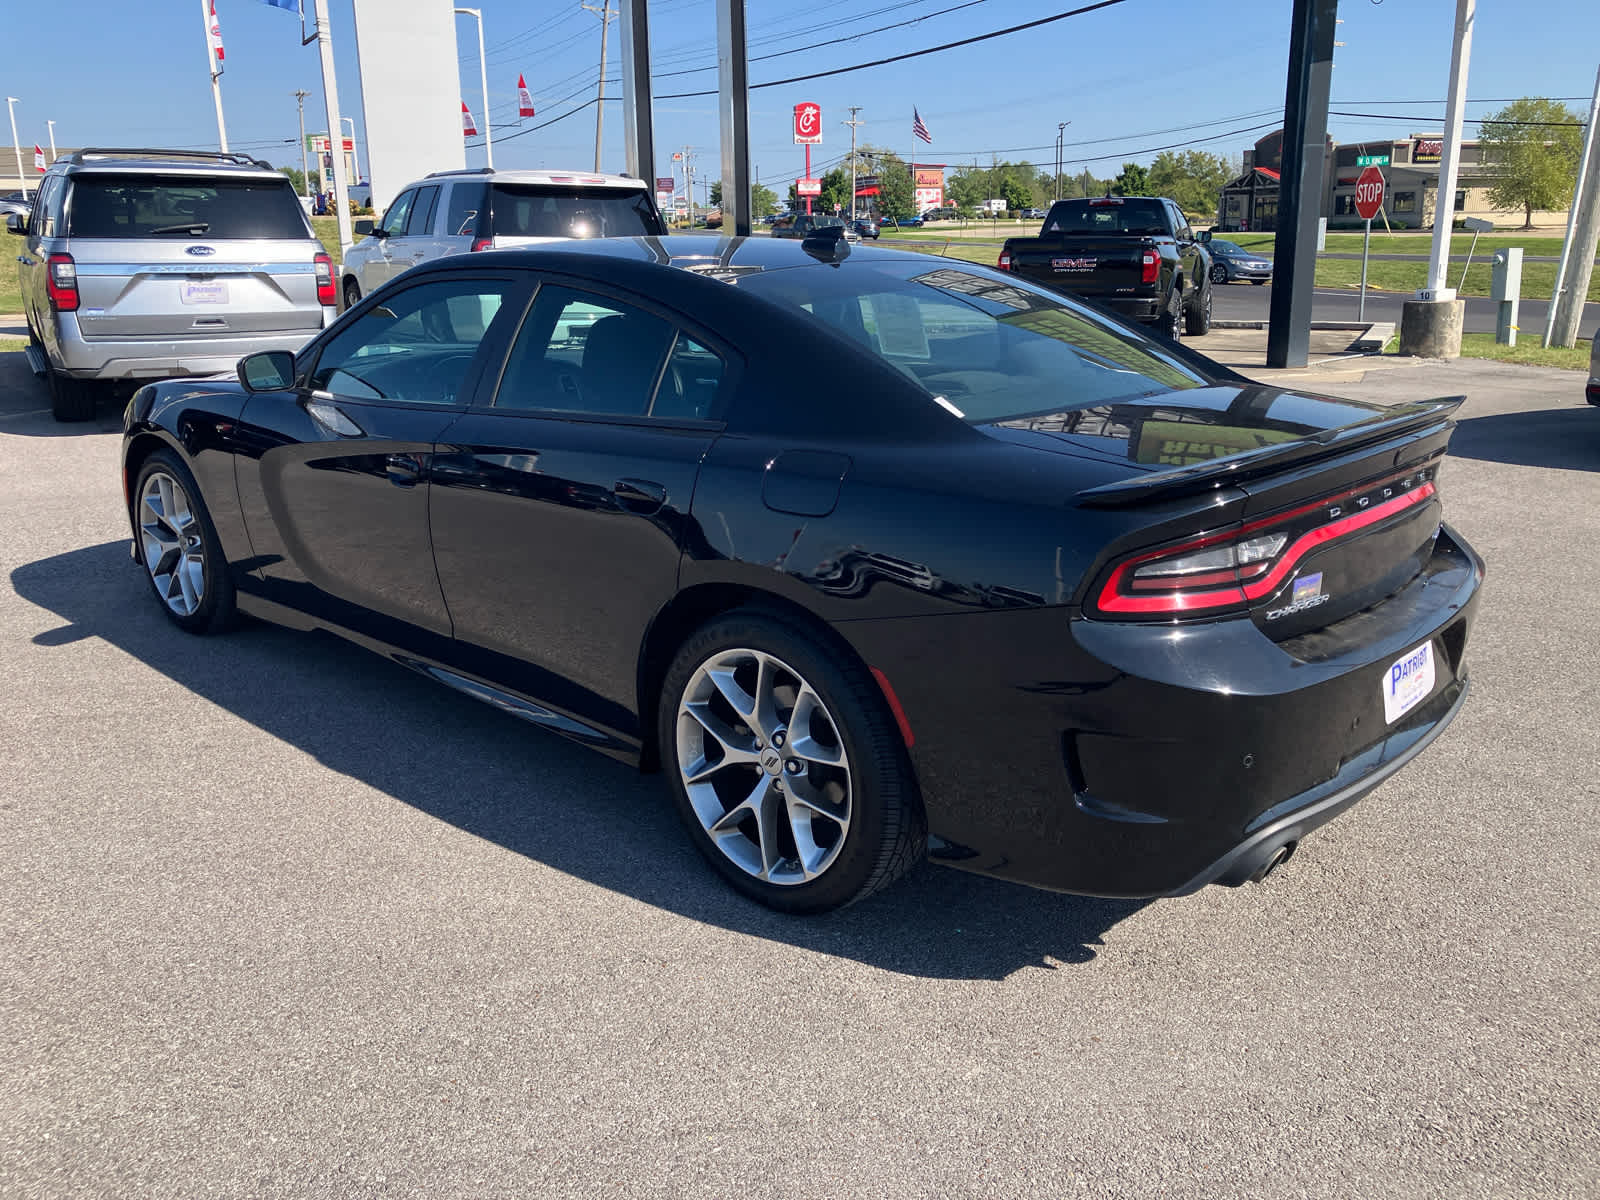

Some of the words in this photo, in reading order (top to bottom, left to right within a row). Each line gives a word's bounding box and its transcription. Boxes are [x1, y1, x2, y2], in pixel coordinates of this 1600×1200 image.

[1357, 183, 1382, 203] STOP
[1052, 258, 1097, 267] GMC
[1420, 291, 1430, 300] 10
[1329, 471, 1426, 517] DODGE
[1265, 592, 1330, 620] CHARGER
[1391, 646, 1428, 697] PATRIOT
